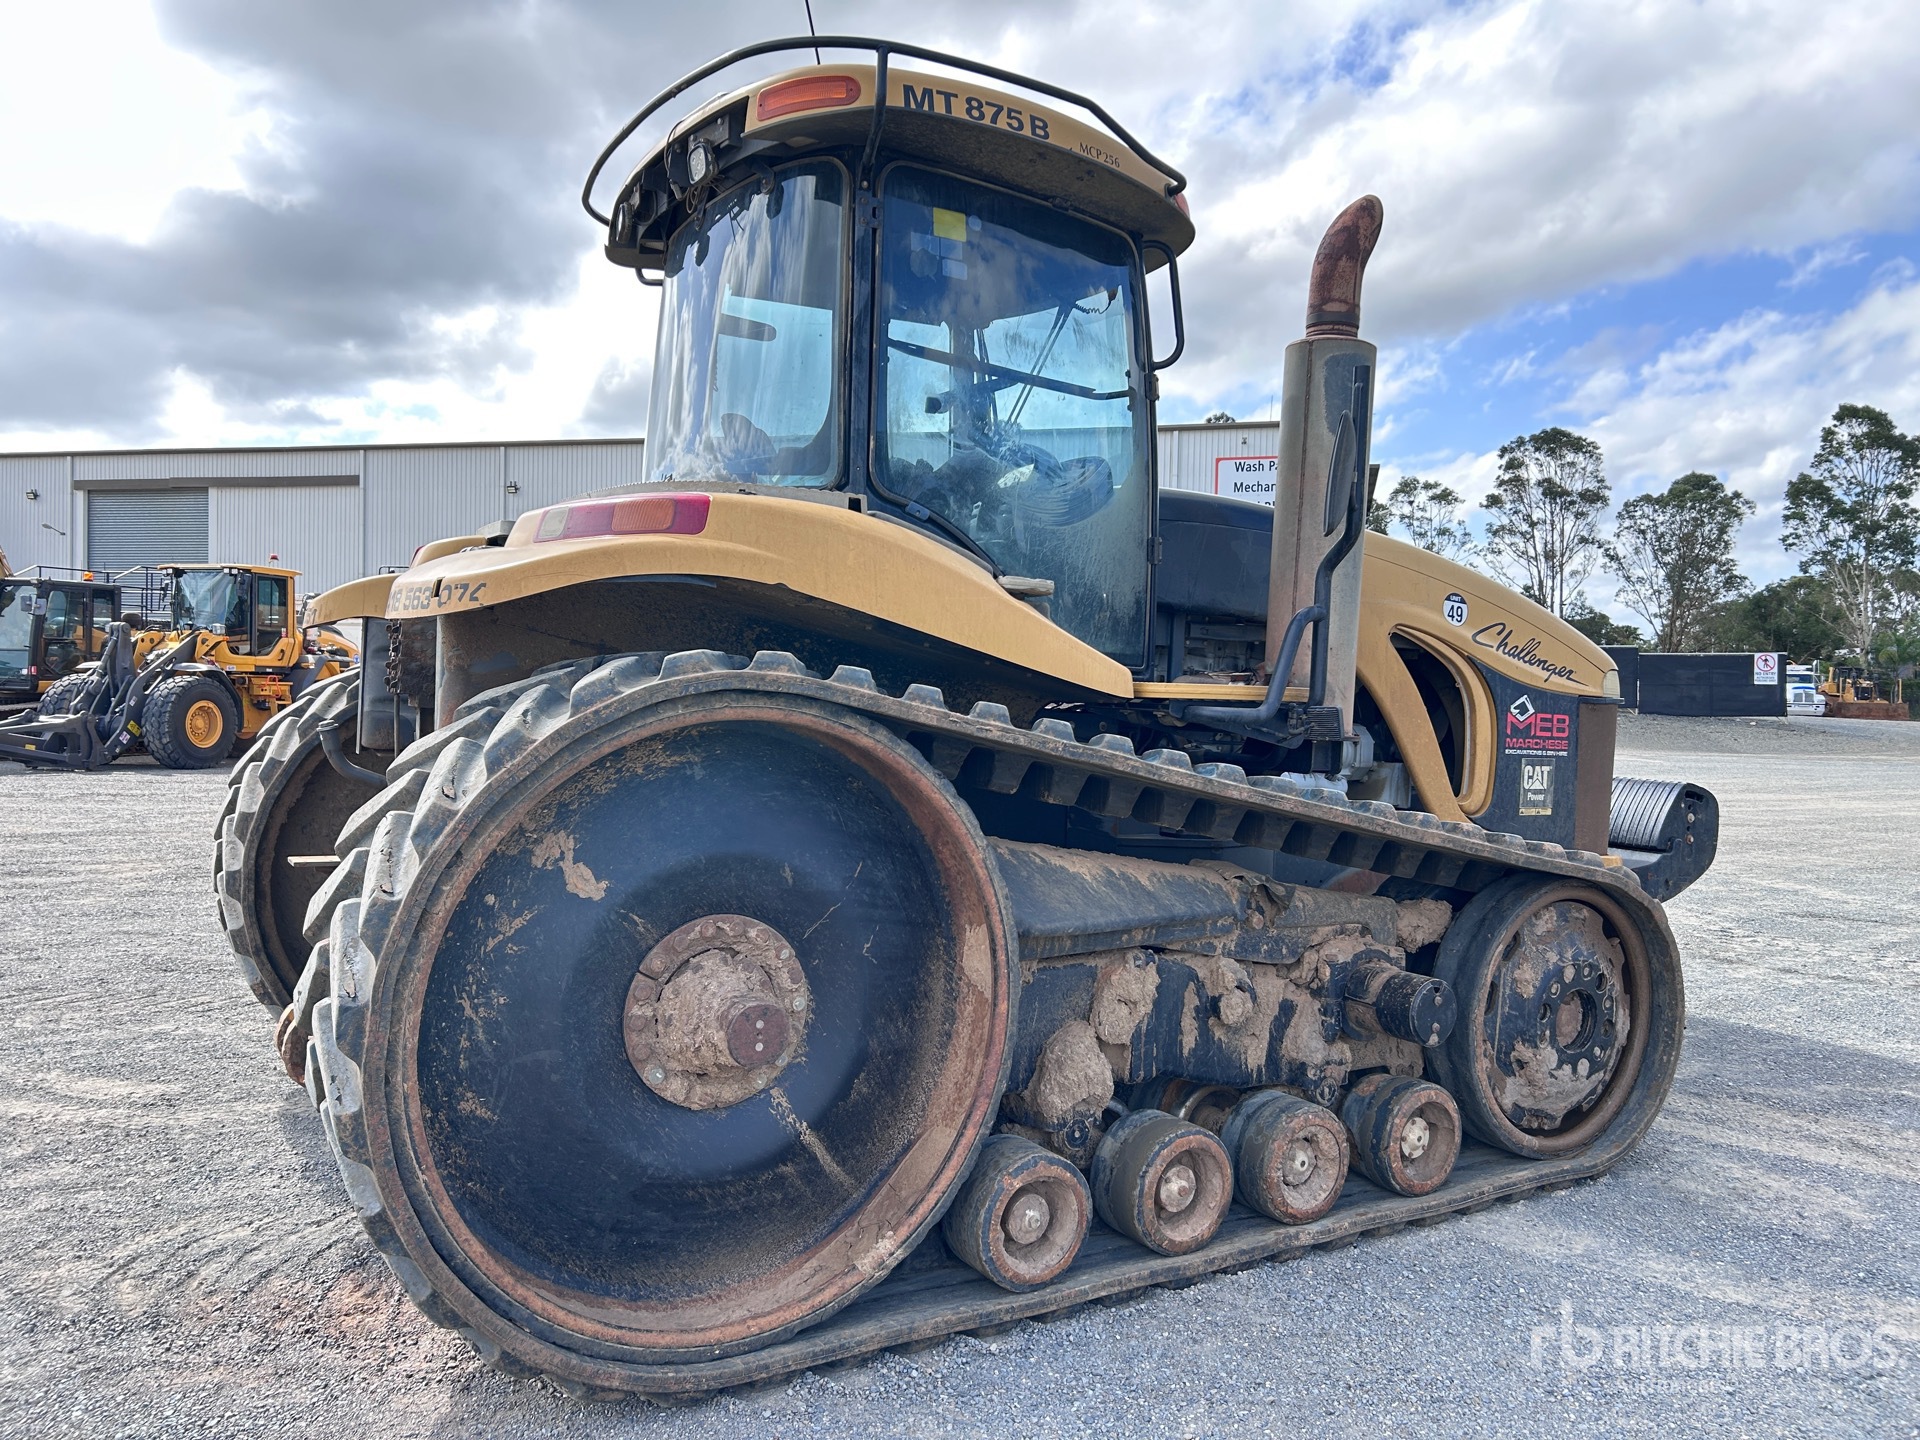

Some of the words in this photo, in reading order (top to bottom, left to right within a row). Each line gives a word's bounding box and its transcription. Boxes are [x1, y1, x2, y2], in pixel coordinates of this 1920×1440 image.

[902, 84, 959, 116] MT
[1234, 460, 1265, 473] Wash
[1450, 594, 1462, 603] UNIT
[1447, 604, 1464, 623] 49
[1471, 622, 1589, 683] Challenger
[1506, 712, 1569, 737] MEB
[1505, 738, 1569, 750] MARCHESE
[1523, 765, 1552, 790] CAT
[1527, 792, 1545, 801] Power
